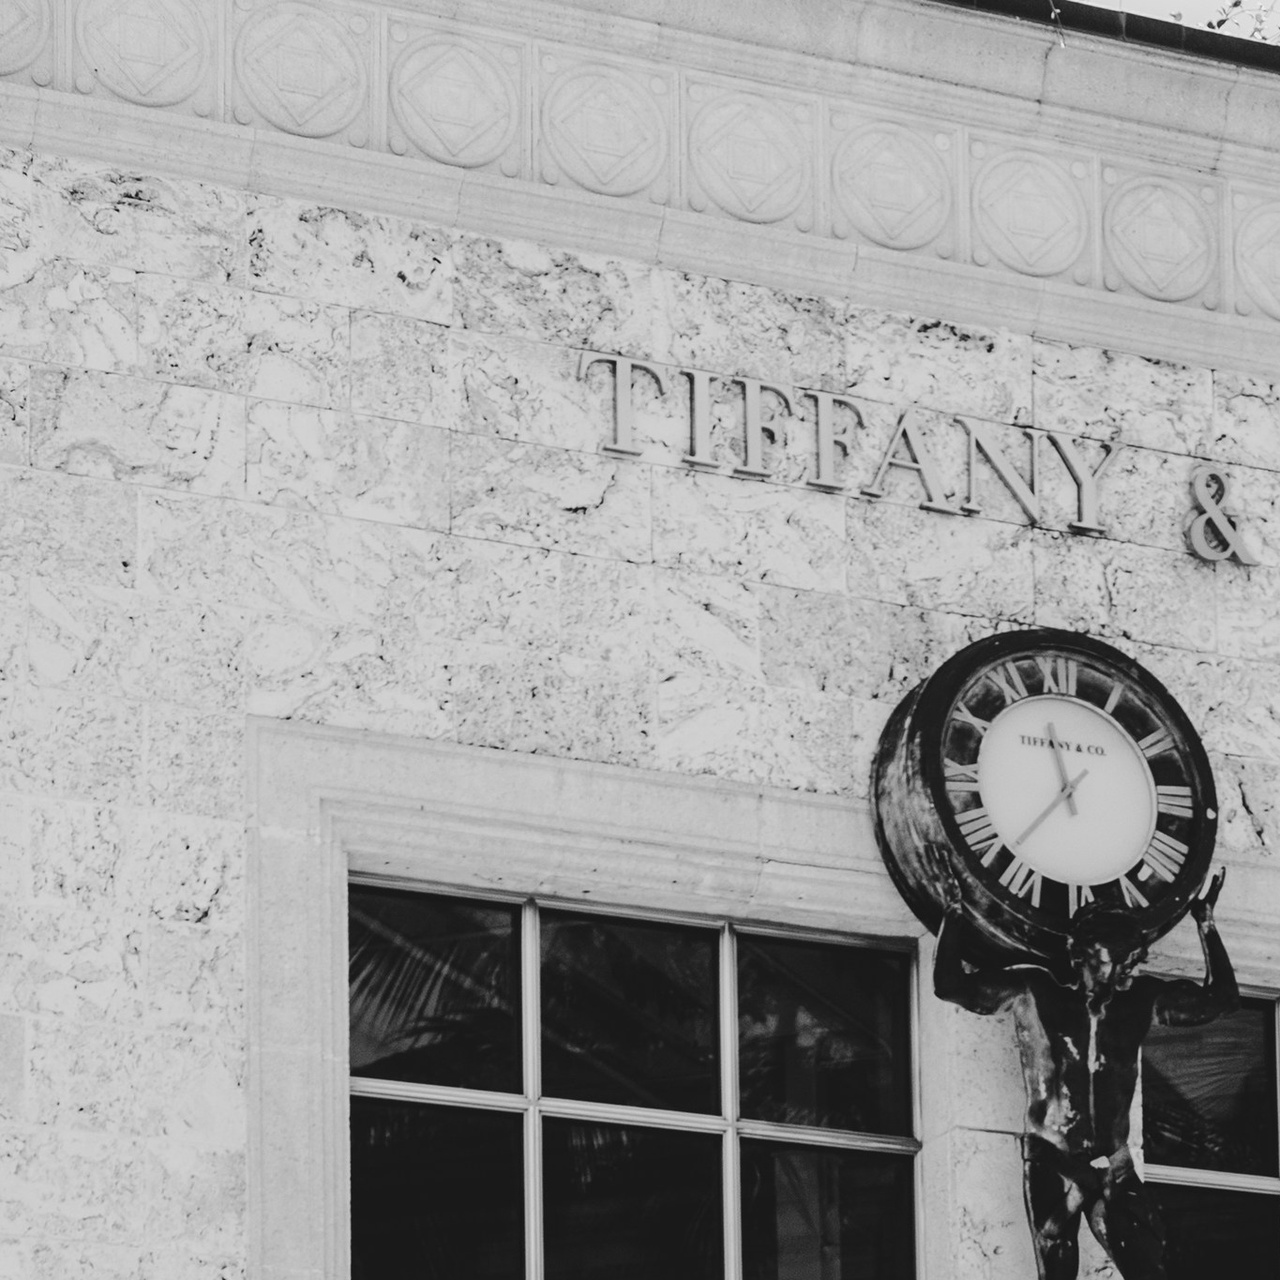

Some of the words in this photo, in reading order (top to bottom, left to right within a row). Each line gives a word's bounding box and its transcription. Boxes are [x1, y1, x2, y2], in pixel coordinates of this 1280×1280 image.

[577, 350, 1127, 536] TIFFANY
[1184, 463, 1262, 566] &
[985, 661, 1029, 705] XI
[1034, 656, 1077, 696] XII
[952, 700, 991, 736] X
[1104, 683, 1125, 715] I
[1138, 726, 1176, 758] II
[944, 757, 980, 792] IX
[1156, 785, 1193, 819] III
[954, 807, 1003, 868] VIII
[1133, 830, 1189, 884] IIII
[998, 856, 1042, 908] VII
[1118, 874, 1150, 908] V
